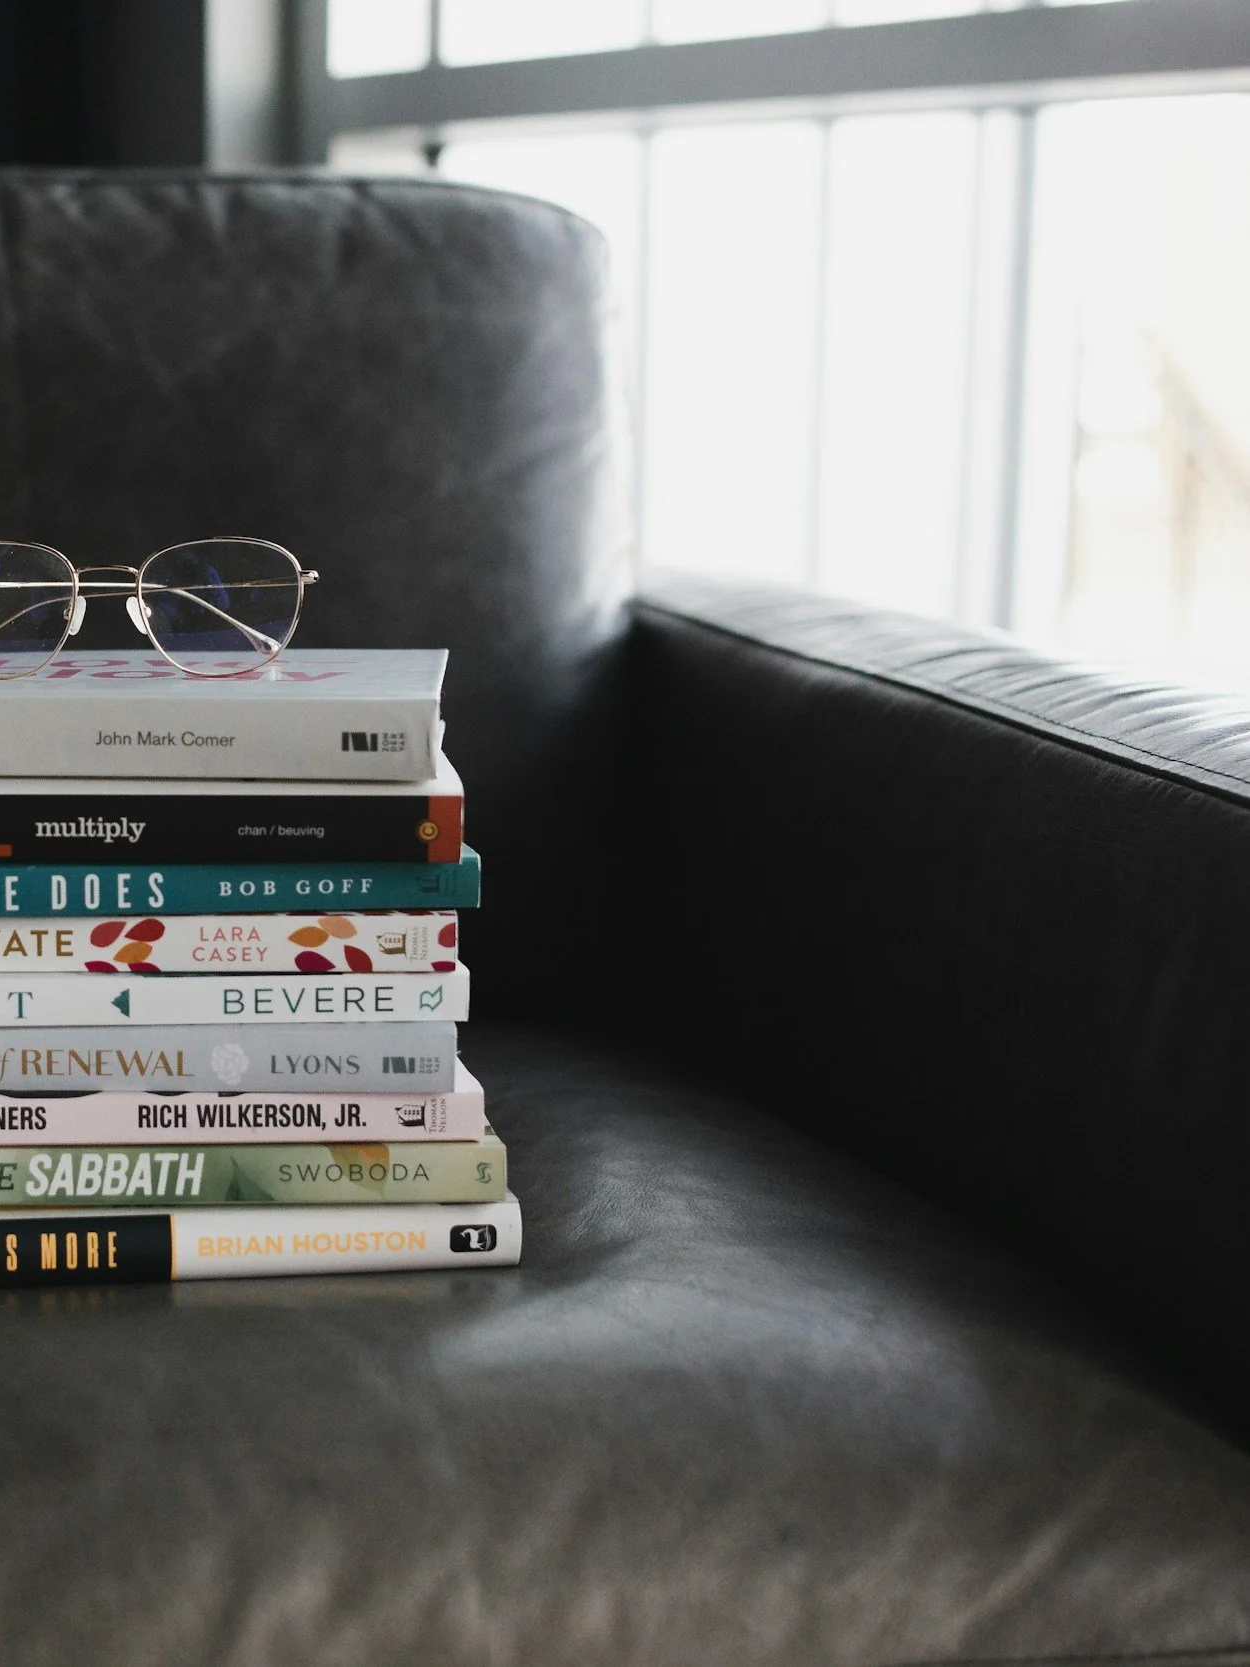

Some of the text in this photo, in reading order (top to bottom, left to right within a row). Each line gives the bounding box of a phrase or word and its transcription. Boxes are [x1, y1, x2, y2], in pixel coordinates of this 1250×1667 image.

[96, 731, 236, 747] John Mark Comer
[35, 817, 146, 843] multiply
[238, 824, 267, 836] chan
[278, 824, 325, 838] beuving
[51, 872, 165, 911] DOES
[219, 878, 374, 897] BOB GOFF
[199, 926, 262, 942] LARA
[192, 947, 269, 962] CASEY
[223, 985, 395, 1015] BEVERE
[21, 1048, 196, 1077] RENEWAL
[270, 1054, 361, 1075] LYONS
[138, 1102, 367, 1131] RICH WILKERSON, JR.
[25, 1152, 206, 1197] SABBATH
[279, 1163, 430, 1182] SWOBODA
[41, 1231, 118, 1270] MORE
[197, 1231, 426, 1257] BRIAN HOUSTON
